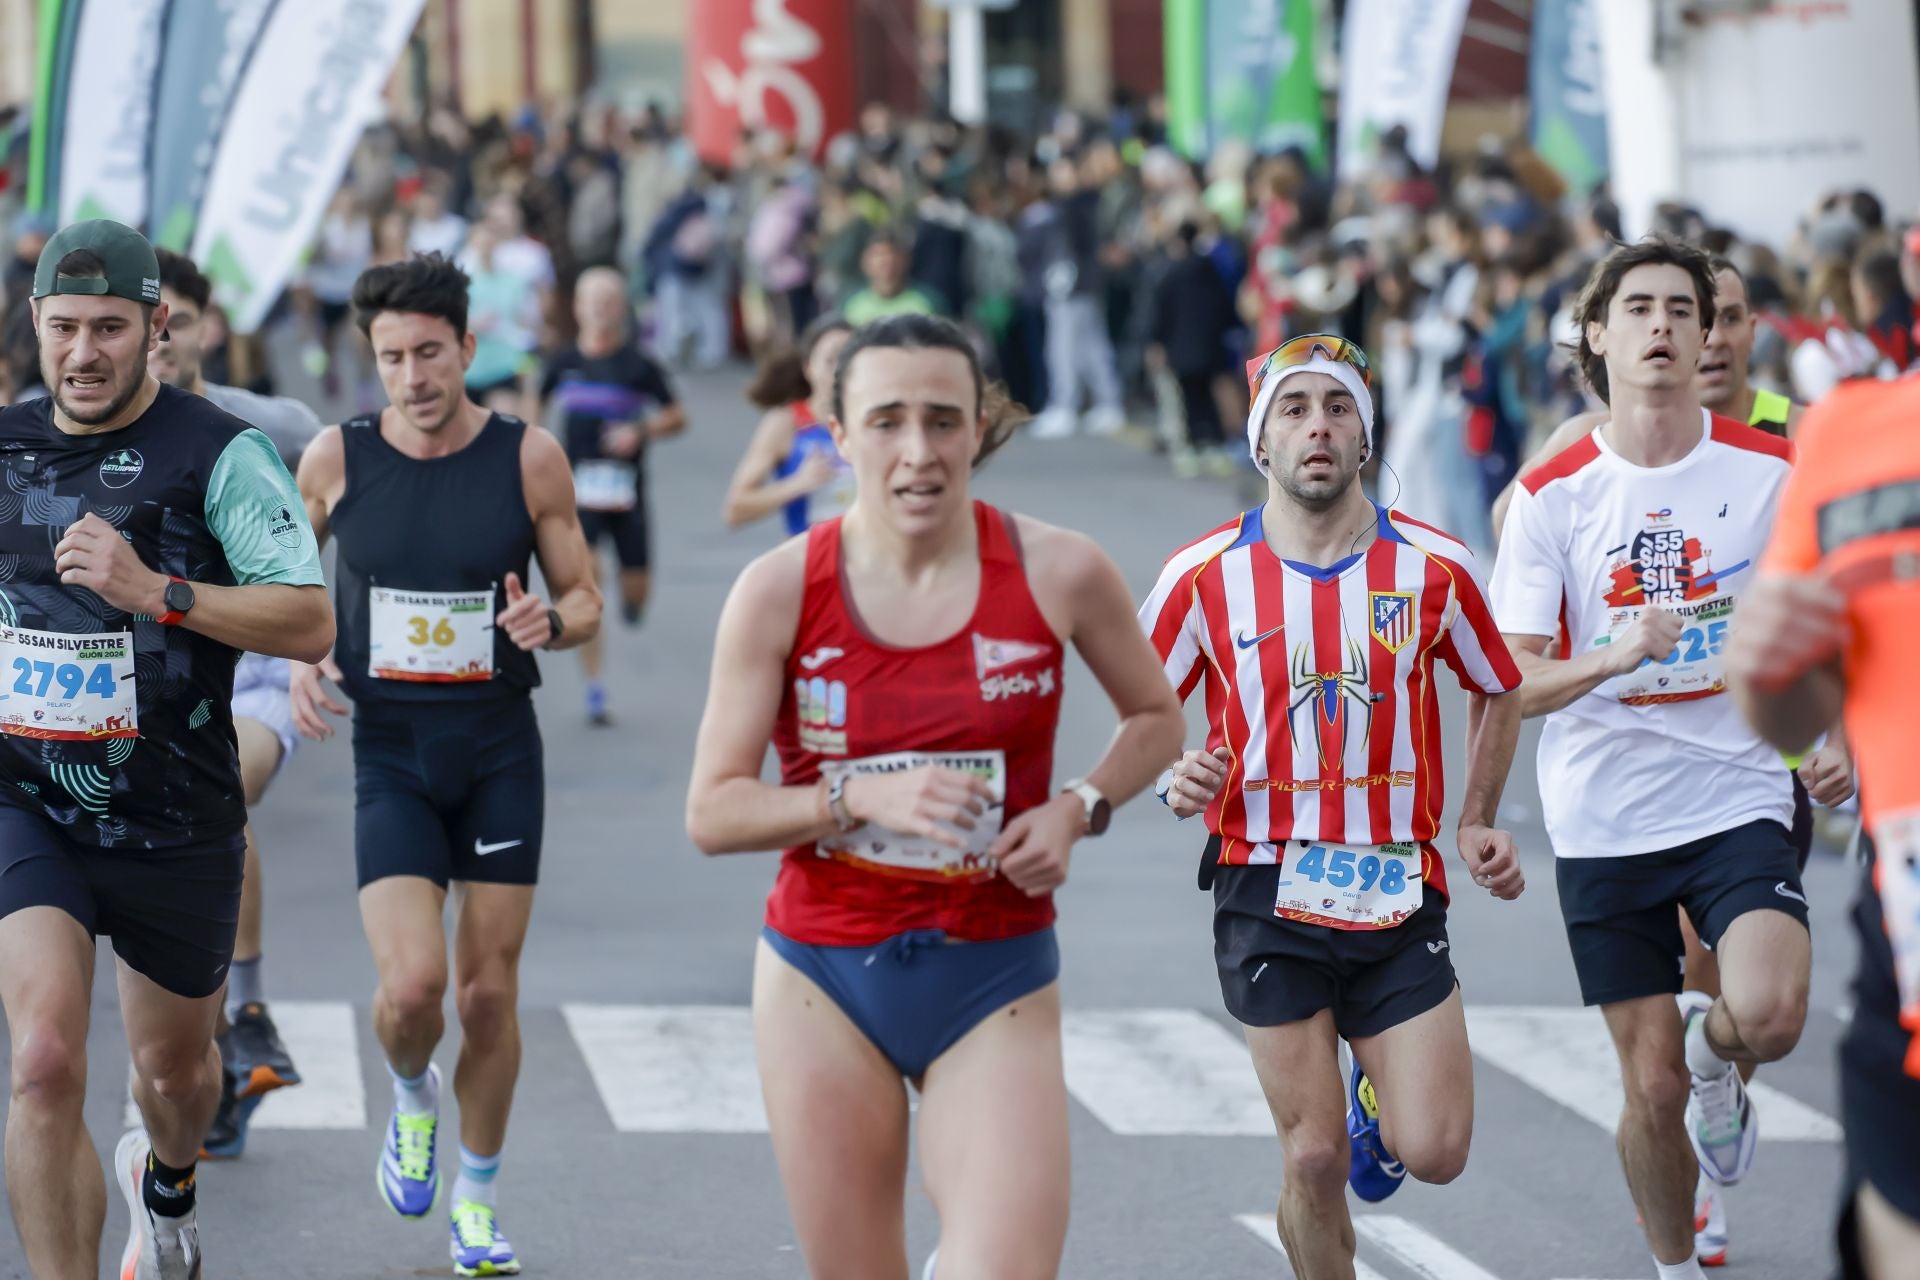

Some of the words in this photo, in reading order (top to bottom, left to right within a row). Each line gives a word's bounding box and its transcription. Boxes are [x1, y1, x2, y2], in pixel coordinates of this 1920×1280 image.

[1654, 531, 1684, 552] 55
[1639, 547, 1683, 569] SAN
[1641, 568, 1683, 592] SIL
[1676, 596, 1733, 616] SILVESTRE
[18, 633, 31, 646] 55
[32, 635, 55, 649] SAN
[57, 638, 125, 650] SILVESTRE
[407, 616, 456, 647] 36
[104, 650, 124, 658] 2024
[1640, 621, 1729, 667] 25
[12, 656, 117, 700] 2794
[1295, 845, 1406, 896] 4598
[1342, 891, 1362, 900] DAVID
